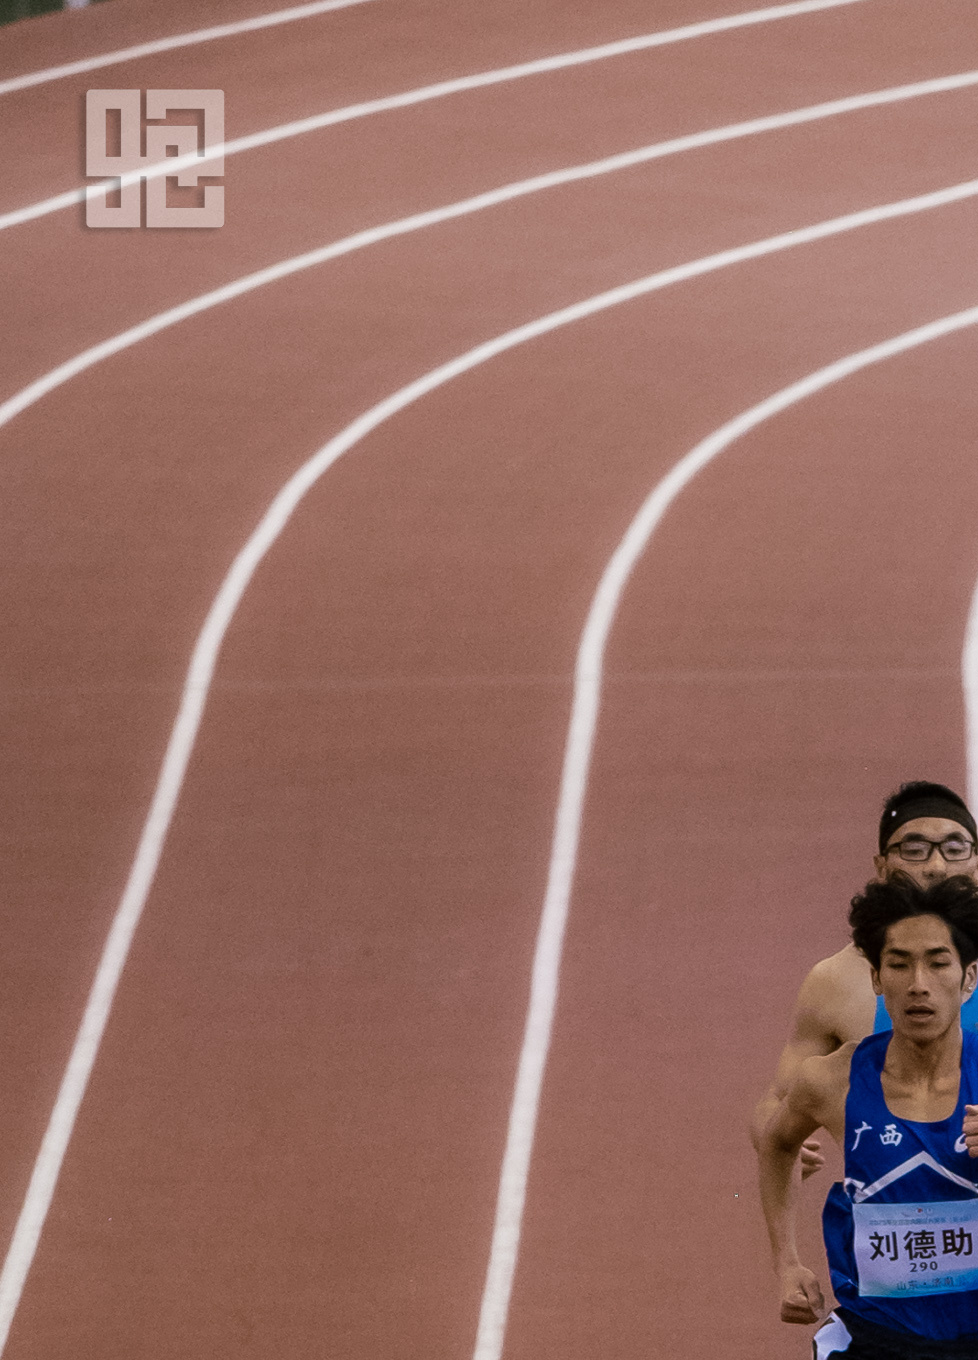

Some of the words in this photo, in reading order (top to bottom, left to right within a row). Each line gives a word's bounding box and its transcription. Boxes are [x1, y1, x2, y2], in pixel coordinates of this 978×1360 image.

[851, 1121, 903, 1151] 广西
[868, 1226, 973, 1262] 刘德助
[909, 1261, 938, 1273] 290
